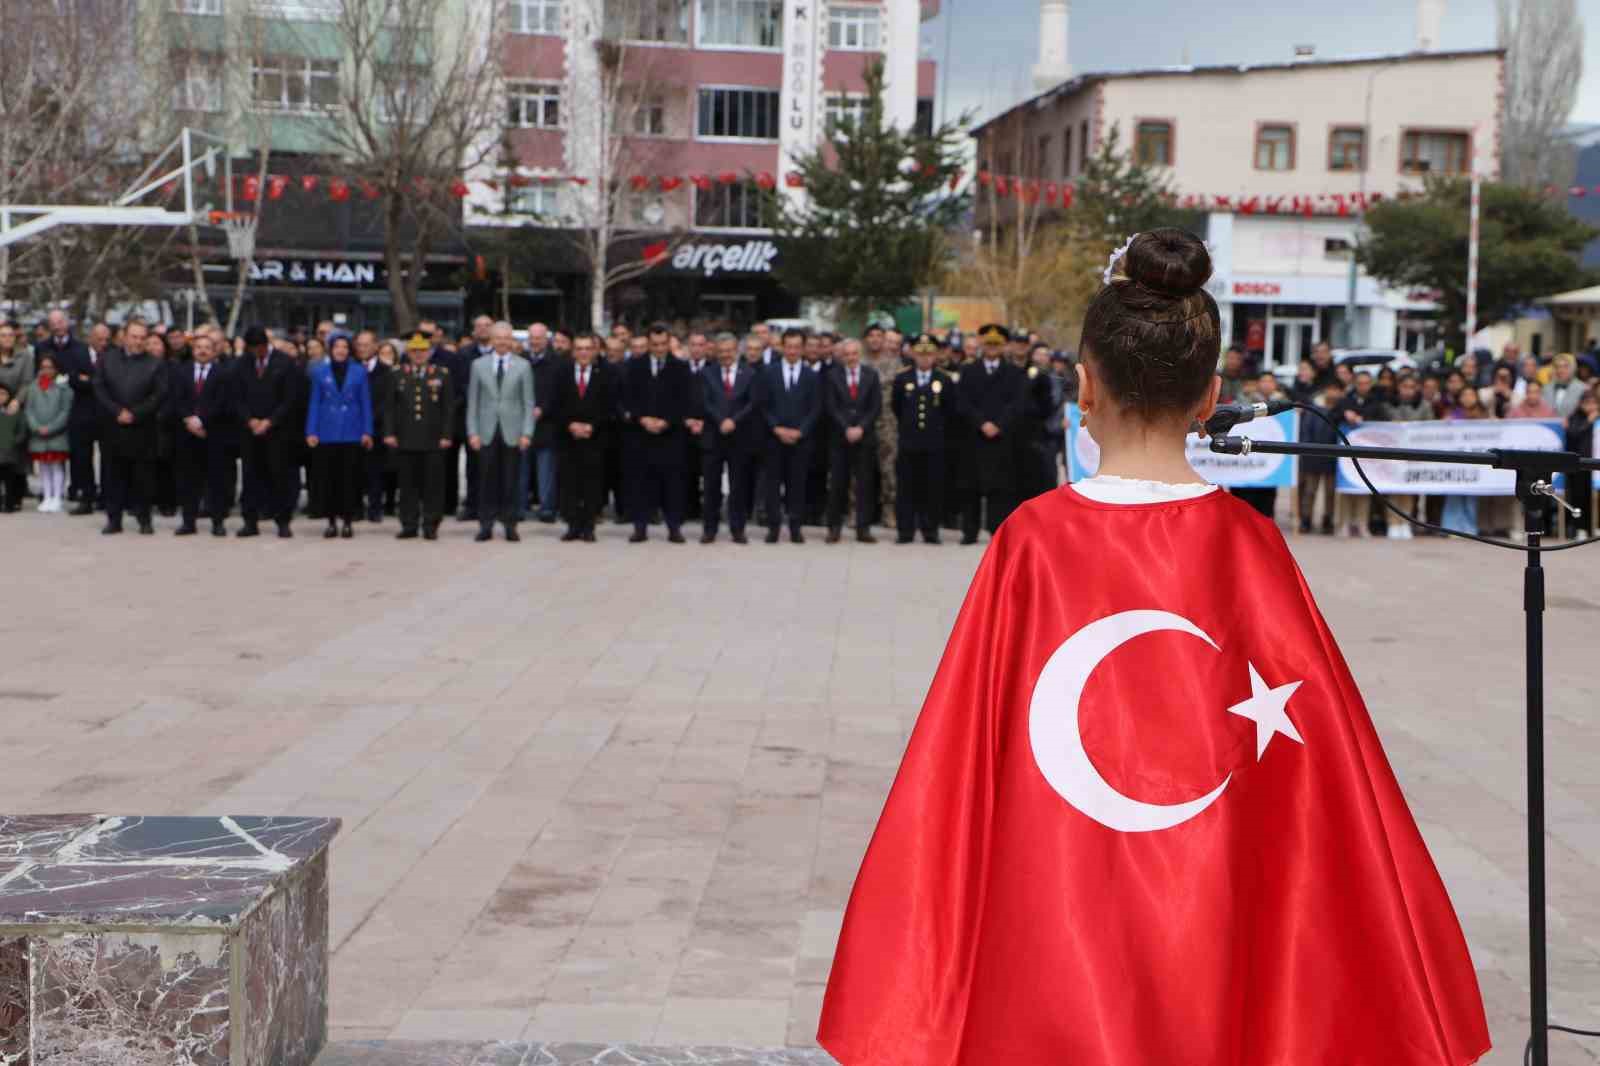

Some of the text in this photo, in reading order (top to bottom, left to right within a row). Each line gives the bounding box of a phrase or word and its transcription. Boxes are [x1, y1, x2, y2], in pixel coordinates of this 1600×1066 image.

[672, 240, 778, 277] arçelik
[290, 261, 306, 281] &
[314, 261, 375, 282] HAN
[1231, 282, 1281, 296] BOSCH
